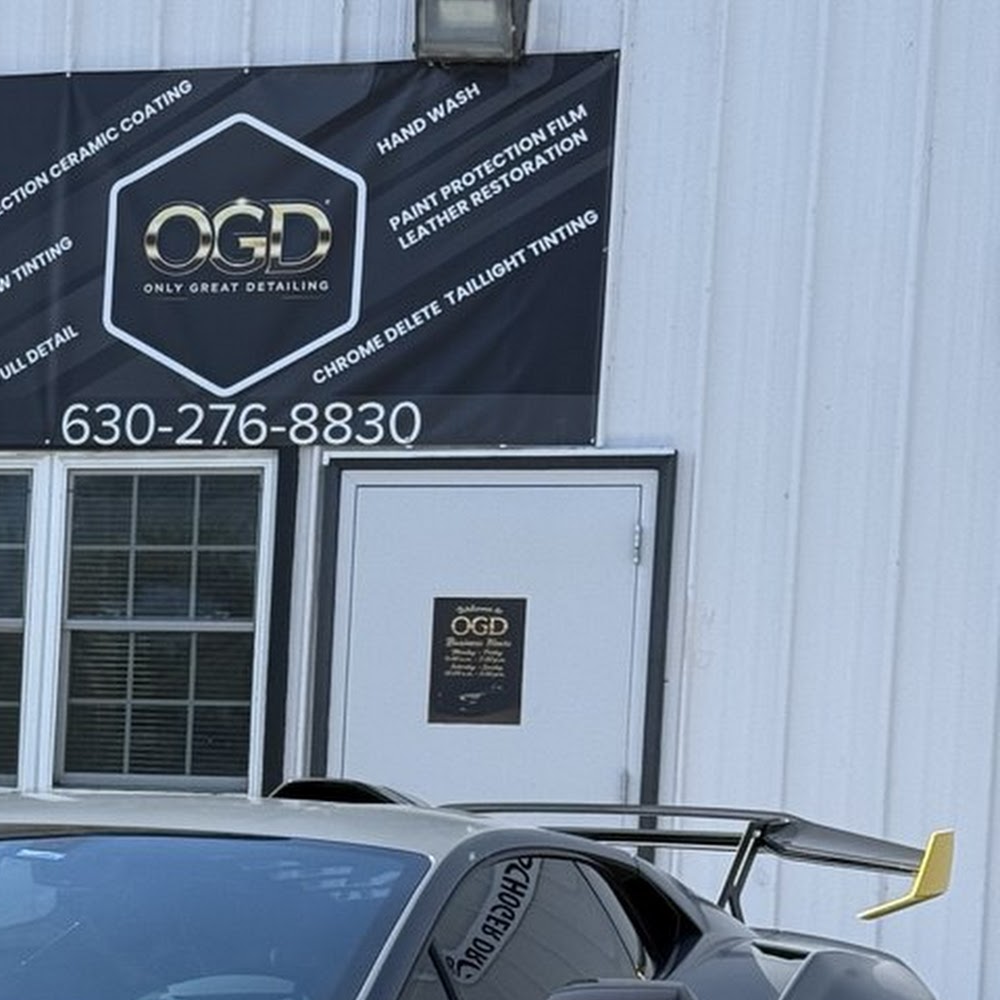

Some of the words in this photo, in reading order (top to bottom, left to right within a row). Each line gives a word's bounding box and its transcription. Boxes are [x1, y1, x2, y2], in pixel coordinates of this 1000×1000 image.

[49, 127, 120, 179] CERAMIC
[120, 79, 193, 133] COATING
[376, 116, 427, 155] HAND
[427, 82, 481, 124] WASH
[388, 192, 438, 231] PAINT
[441, 127, 546, 199] PROTECTION
[546, 104, 588, 138] FILM
[397, 201, 471, 250] LEATHER
[471, 128, 589, 207] RESTORATION
[11, 235, 74, 282] TINTING
[144, 199, 332, 275] OGD
[143, 282, 184, 295] ONLY
[189, 281, 240, 294] GREAT
[245, 279, 330, 293] DETAILING
[312, 335, 385, 385] CHROME
[383, 300, 443, 342] DELETE
[443, 250, 528, 306] TAILLIGHT
[527, 209, 599, 257] TINTING
[26, 324, 79, 364] DETAIL
[61, 401, 422, 447] 630-276-8830
[451, 616, 509, 636] OGD
